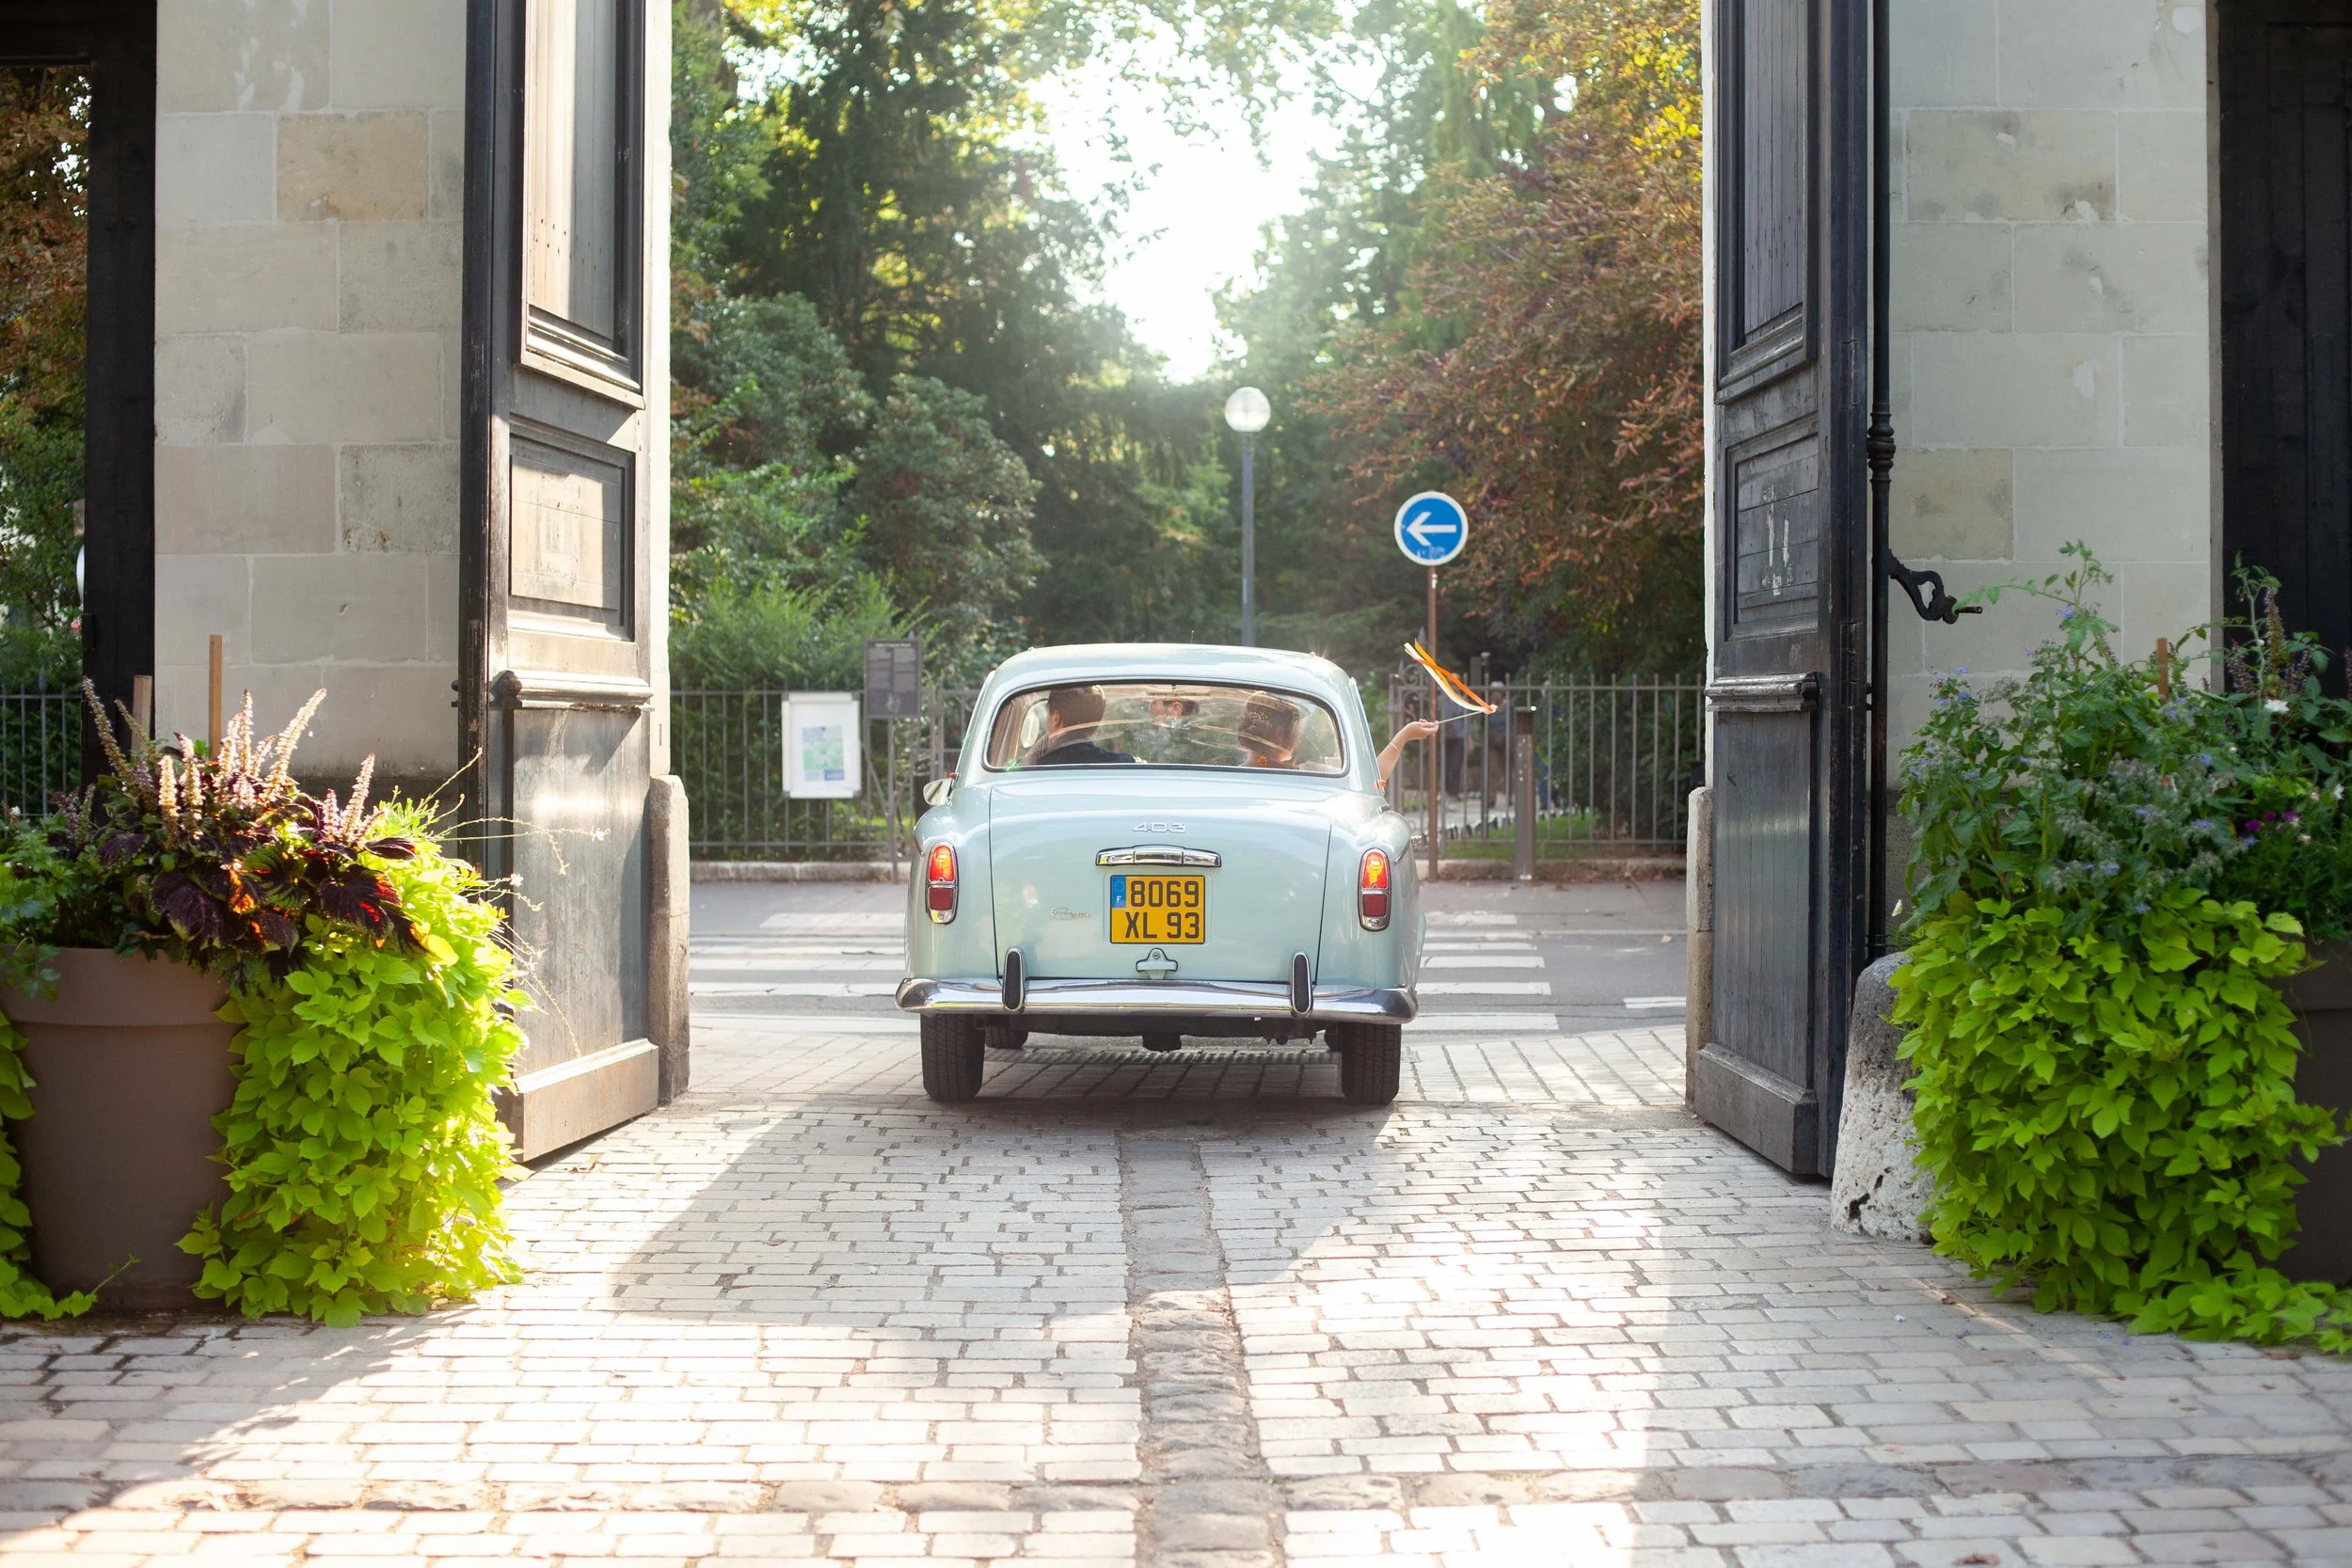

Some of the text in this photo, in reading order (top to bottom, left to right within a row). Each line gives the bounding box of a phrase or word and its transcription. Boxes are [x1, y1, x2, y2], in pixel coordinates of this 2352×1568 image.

[1132, 822, 1186, 833] 403
[1131, 880, 1199, 907] 8069
[1125, 911, 1200, 939] XL 93
